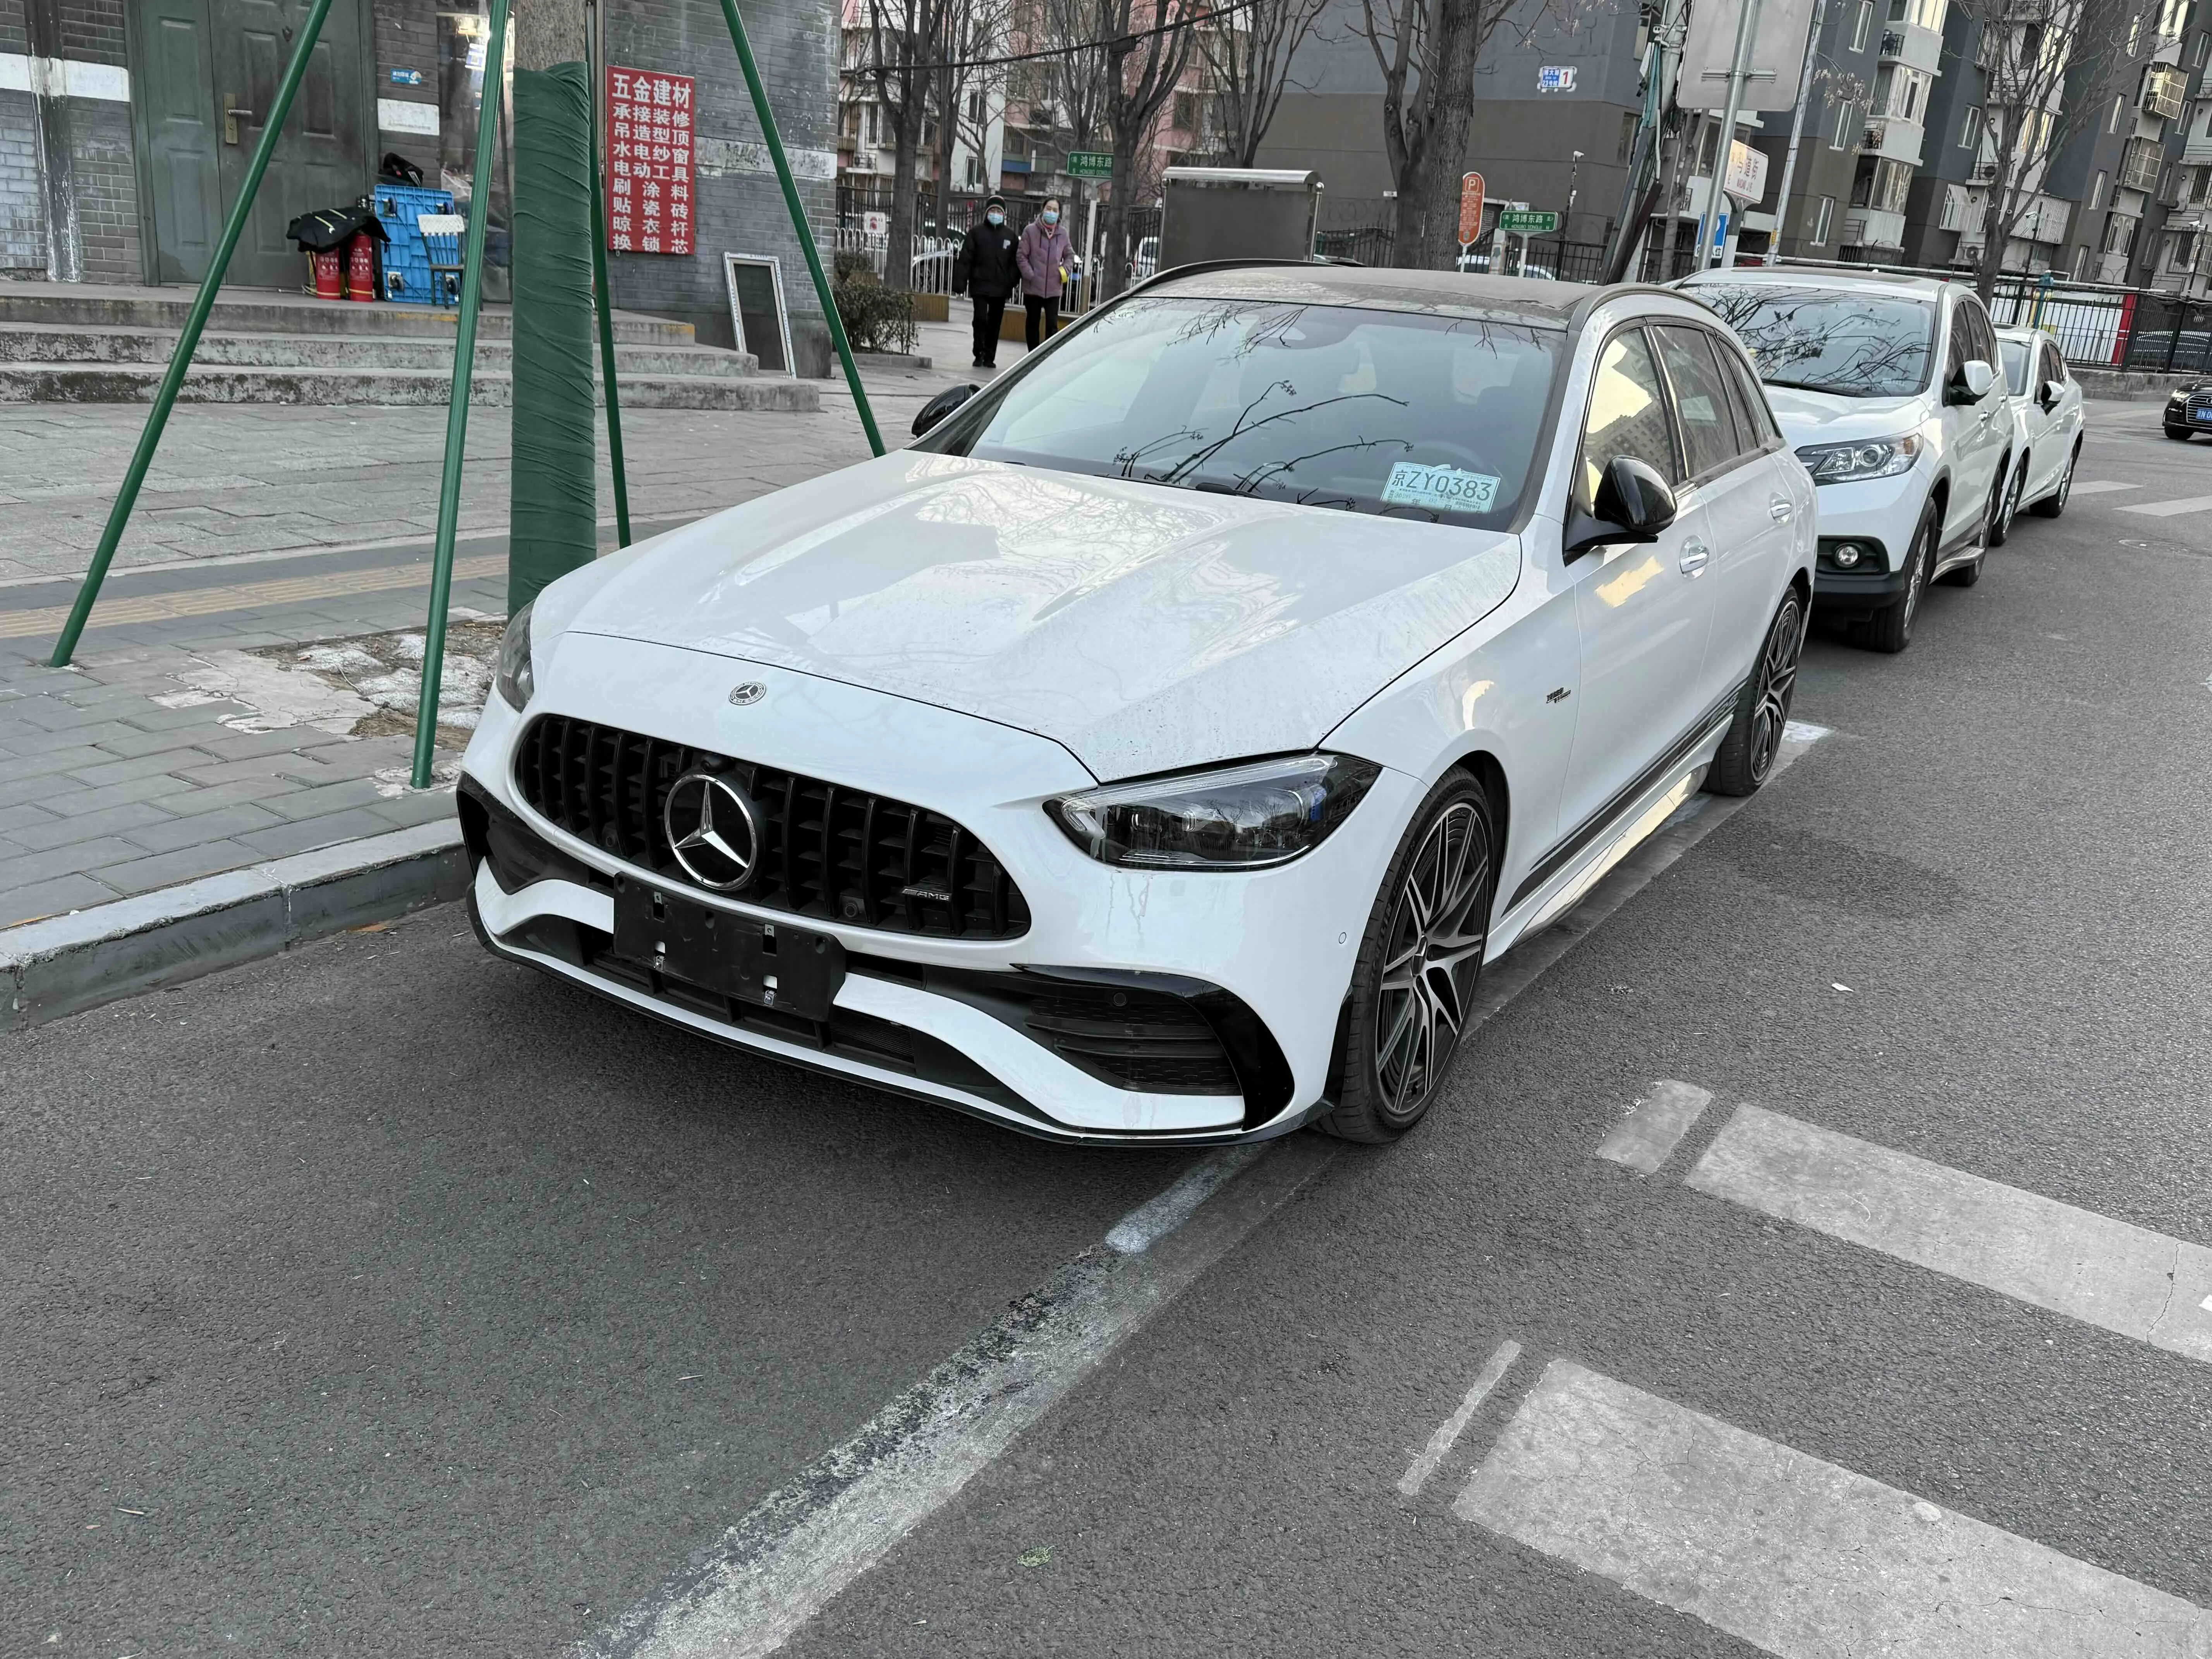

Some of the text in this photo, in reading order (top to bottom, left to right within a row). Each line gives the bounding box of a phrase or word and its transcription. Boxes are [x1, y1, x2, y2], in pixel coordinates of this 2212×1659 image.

[1563, 71, 1568, 84] 1
[612, 73, 691, 109] 五金建材
[613, 102, 690, 128] 承接装修
[614, 122, 690, 147] 吊造型顶
[613, 141, 689, 165] 水电纱窗
[1080, 155, 1112, 167] 鸿博东路
[614, 159, 689, 183] 电动工具
[1468, 179, 1476, 190] P
[1512, 214, 1543, 223] 鸿博东路
[1392, 469, 1492, 501] 京ZY0383
[916, 891, 950, 902] AMG
